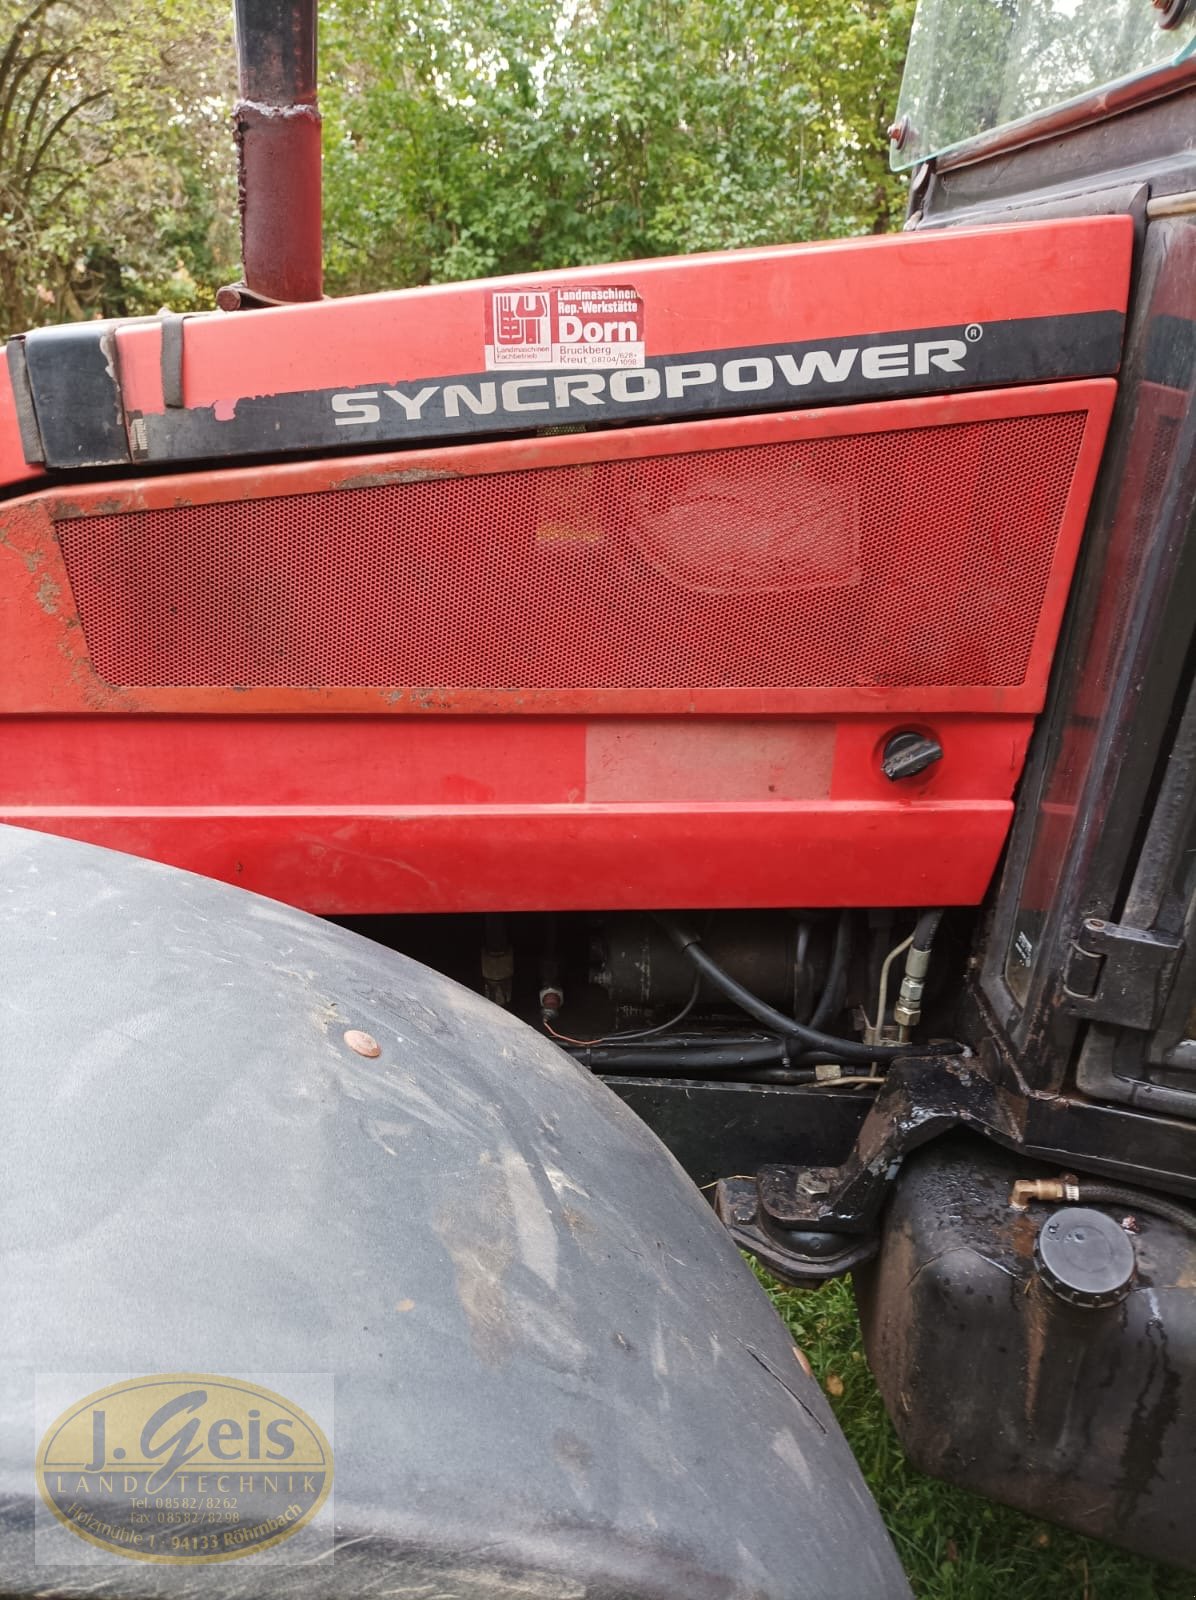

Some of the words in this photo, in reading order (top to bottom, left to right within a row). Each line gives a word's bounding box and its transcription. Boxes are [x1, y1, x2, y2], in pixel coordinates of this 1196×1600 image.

[558, 301, 638, 315] Rep.-Werkstätte
[559, 316, 637, 342] Dorn
[496, 345, 550, 353] Landmaschinen
[560, 346, 611, 356] Bruckberg
[560, 356, 587, 364] Kreut
